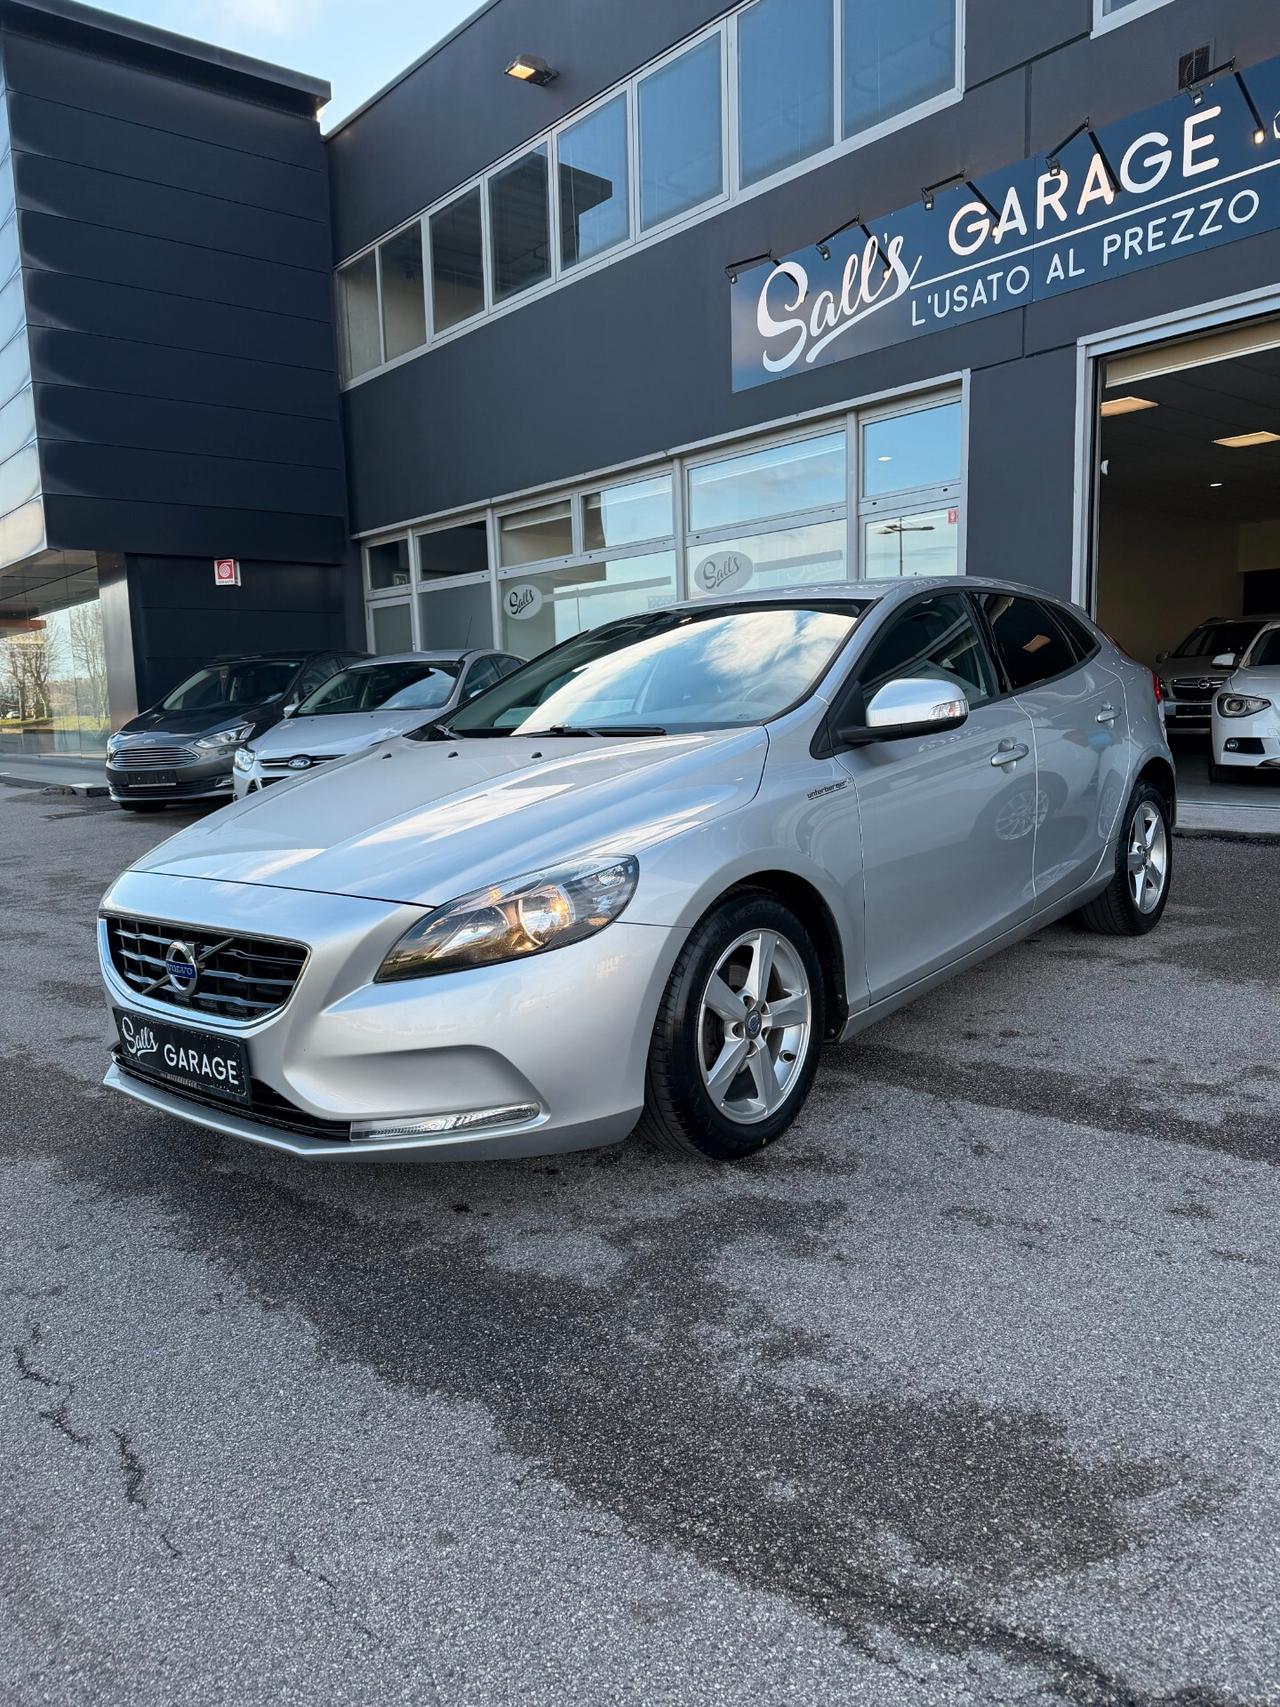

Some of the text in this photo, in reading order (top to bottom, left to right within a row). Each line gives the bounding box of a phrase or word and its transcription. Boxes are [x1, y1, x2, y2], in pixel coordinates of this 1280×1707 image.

[756, 105, 1222, 373] Sall's GARAGE
[911, 189, 1260, 327] L'USATO AL PREZZO
[121, 1016, 158, 1057] Sall's
[163, 1043, 239, 1085] GARAGE
